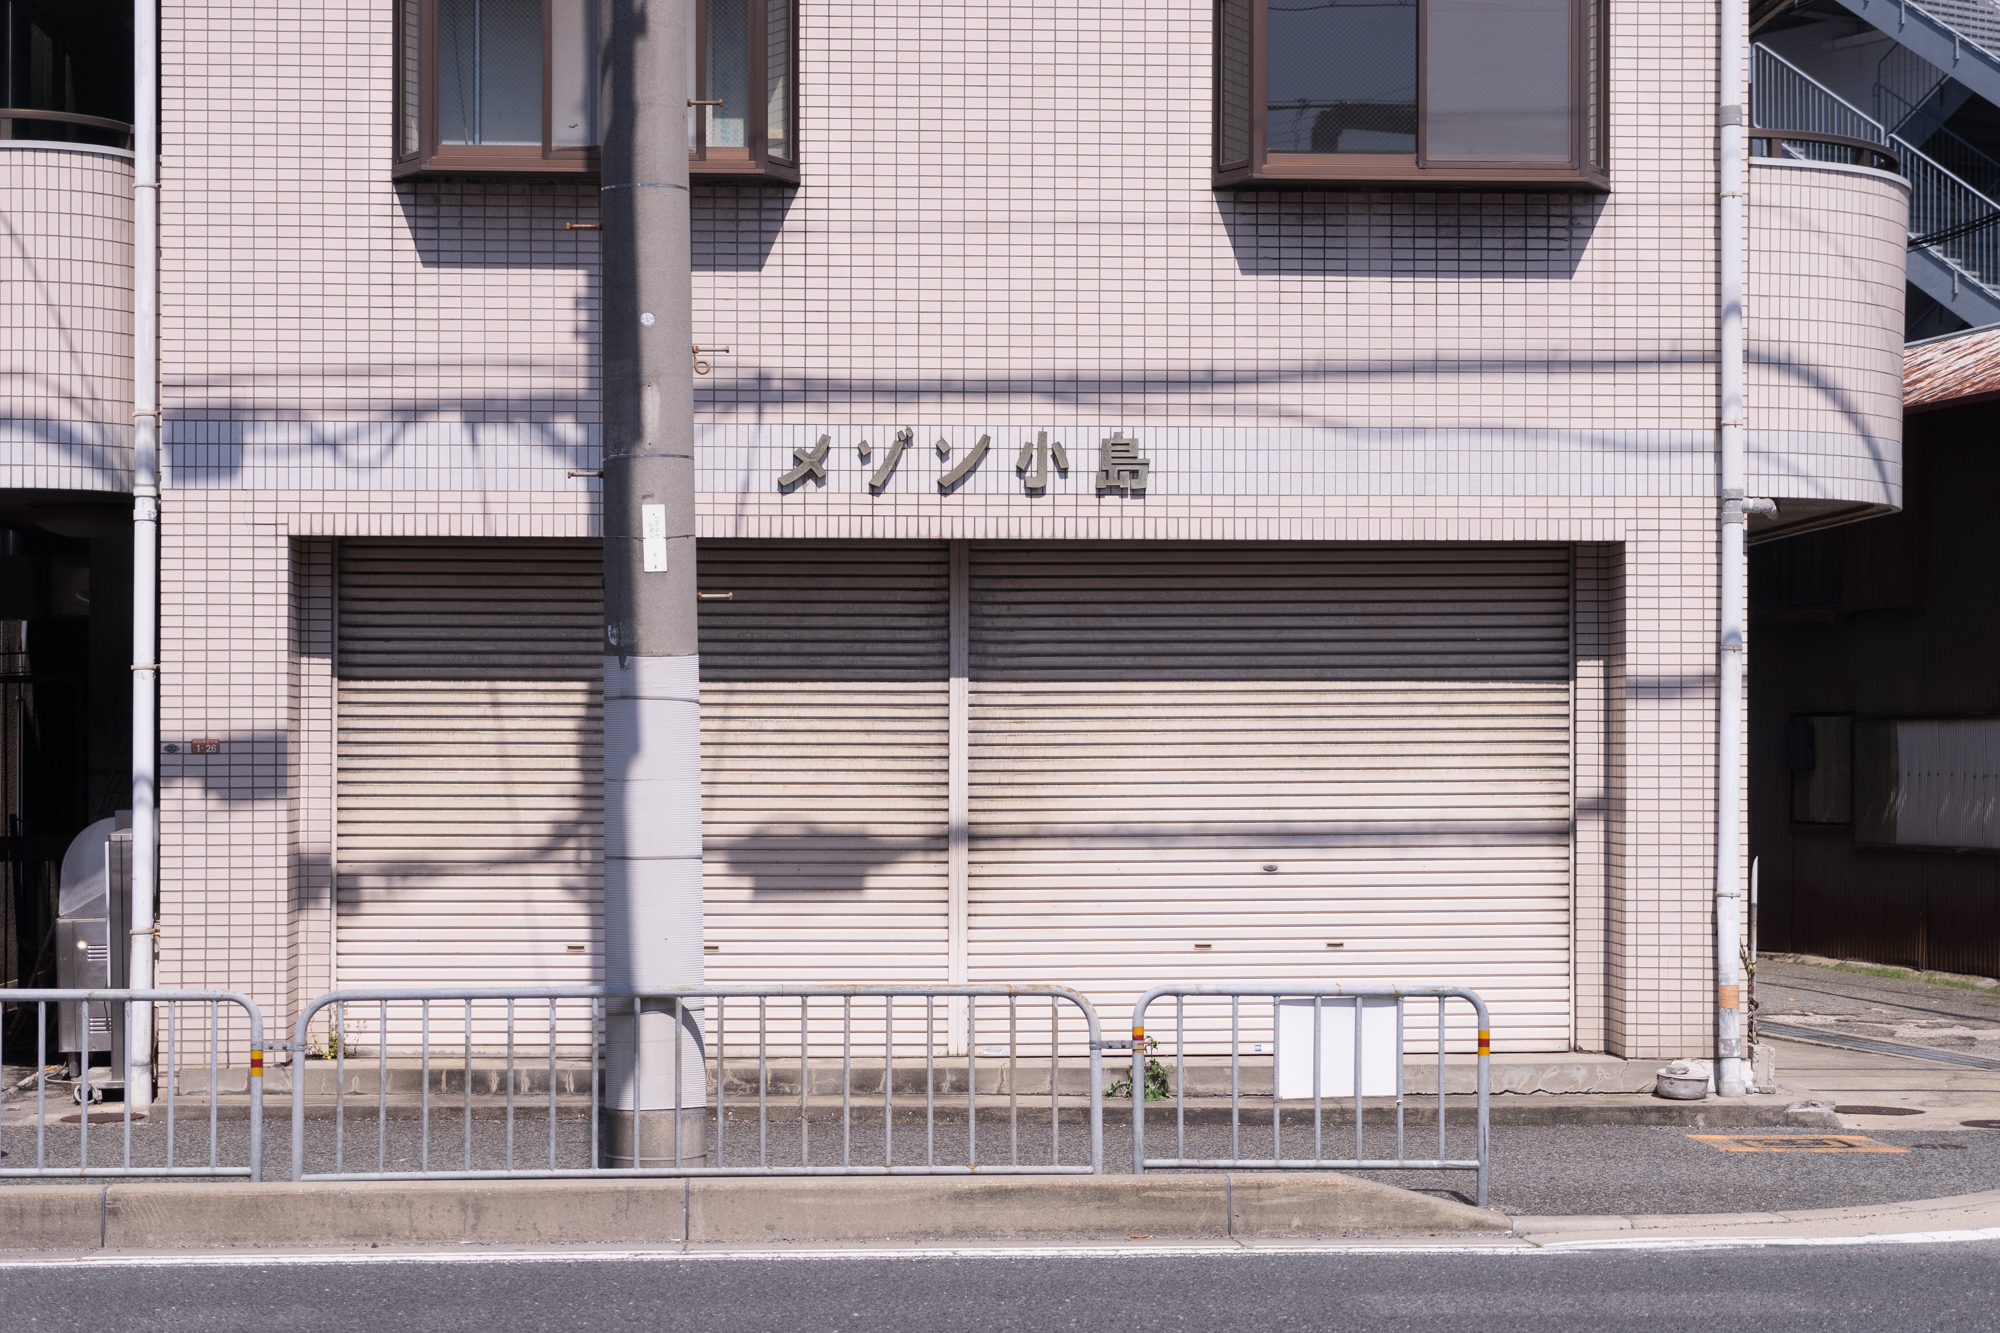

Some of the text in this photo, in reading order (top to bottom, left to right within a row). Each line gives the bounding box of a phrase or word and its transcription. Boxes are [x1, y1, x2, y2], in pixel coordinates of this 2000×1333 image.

[777, 427, 1150, 490] メゾン小島
